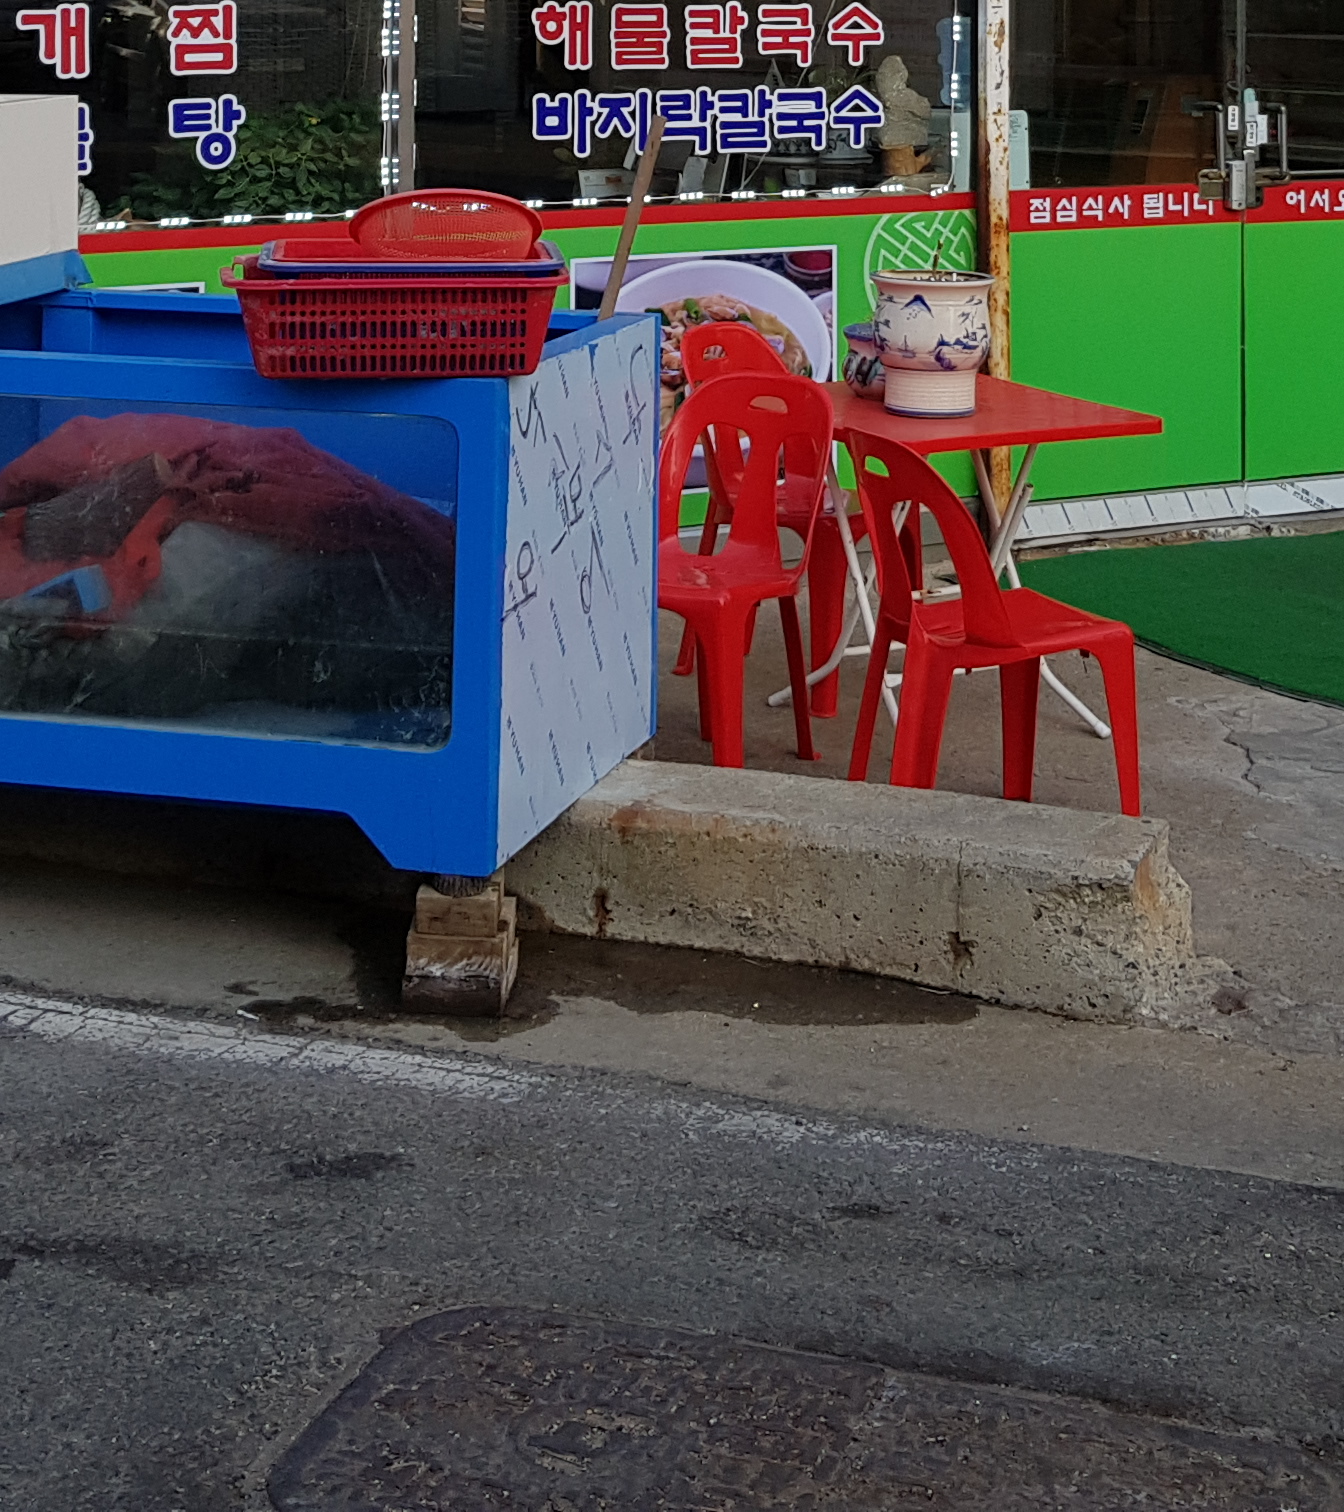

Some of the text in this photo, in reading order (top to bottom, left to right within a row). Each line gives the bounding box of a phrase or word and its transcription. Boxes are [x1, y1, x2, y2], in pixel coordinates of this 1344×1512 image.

[532, 0, 885, 71] 해물칼국수
[532, 85, 885, 158] 바지락칼국수
[1029, 192, 1132, 224] 점심식사
